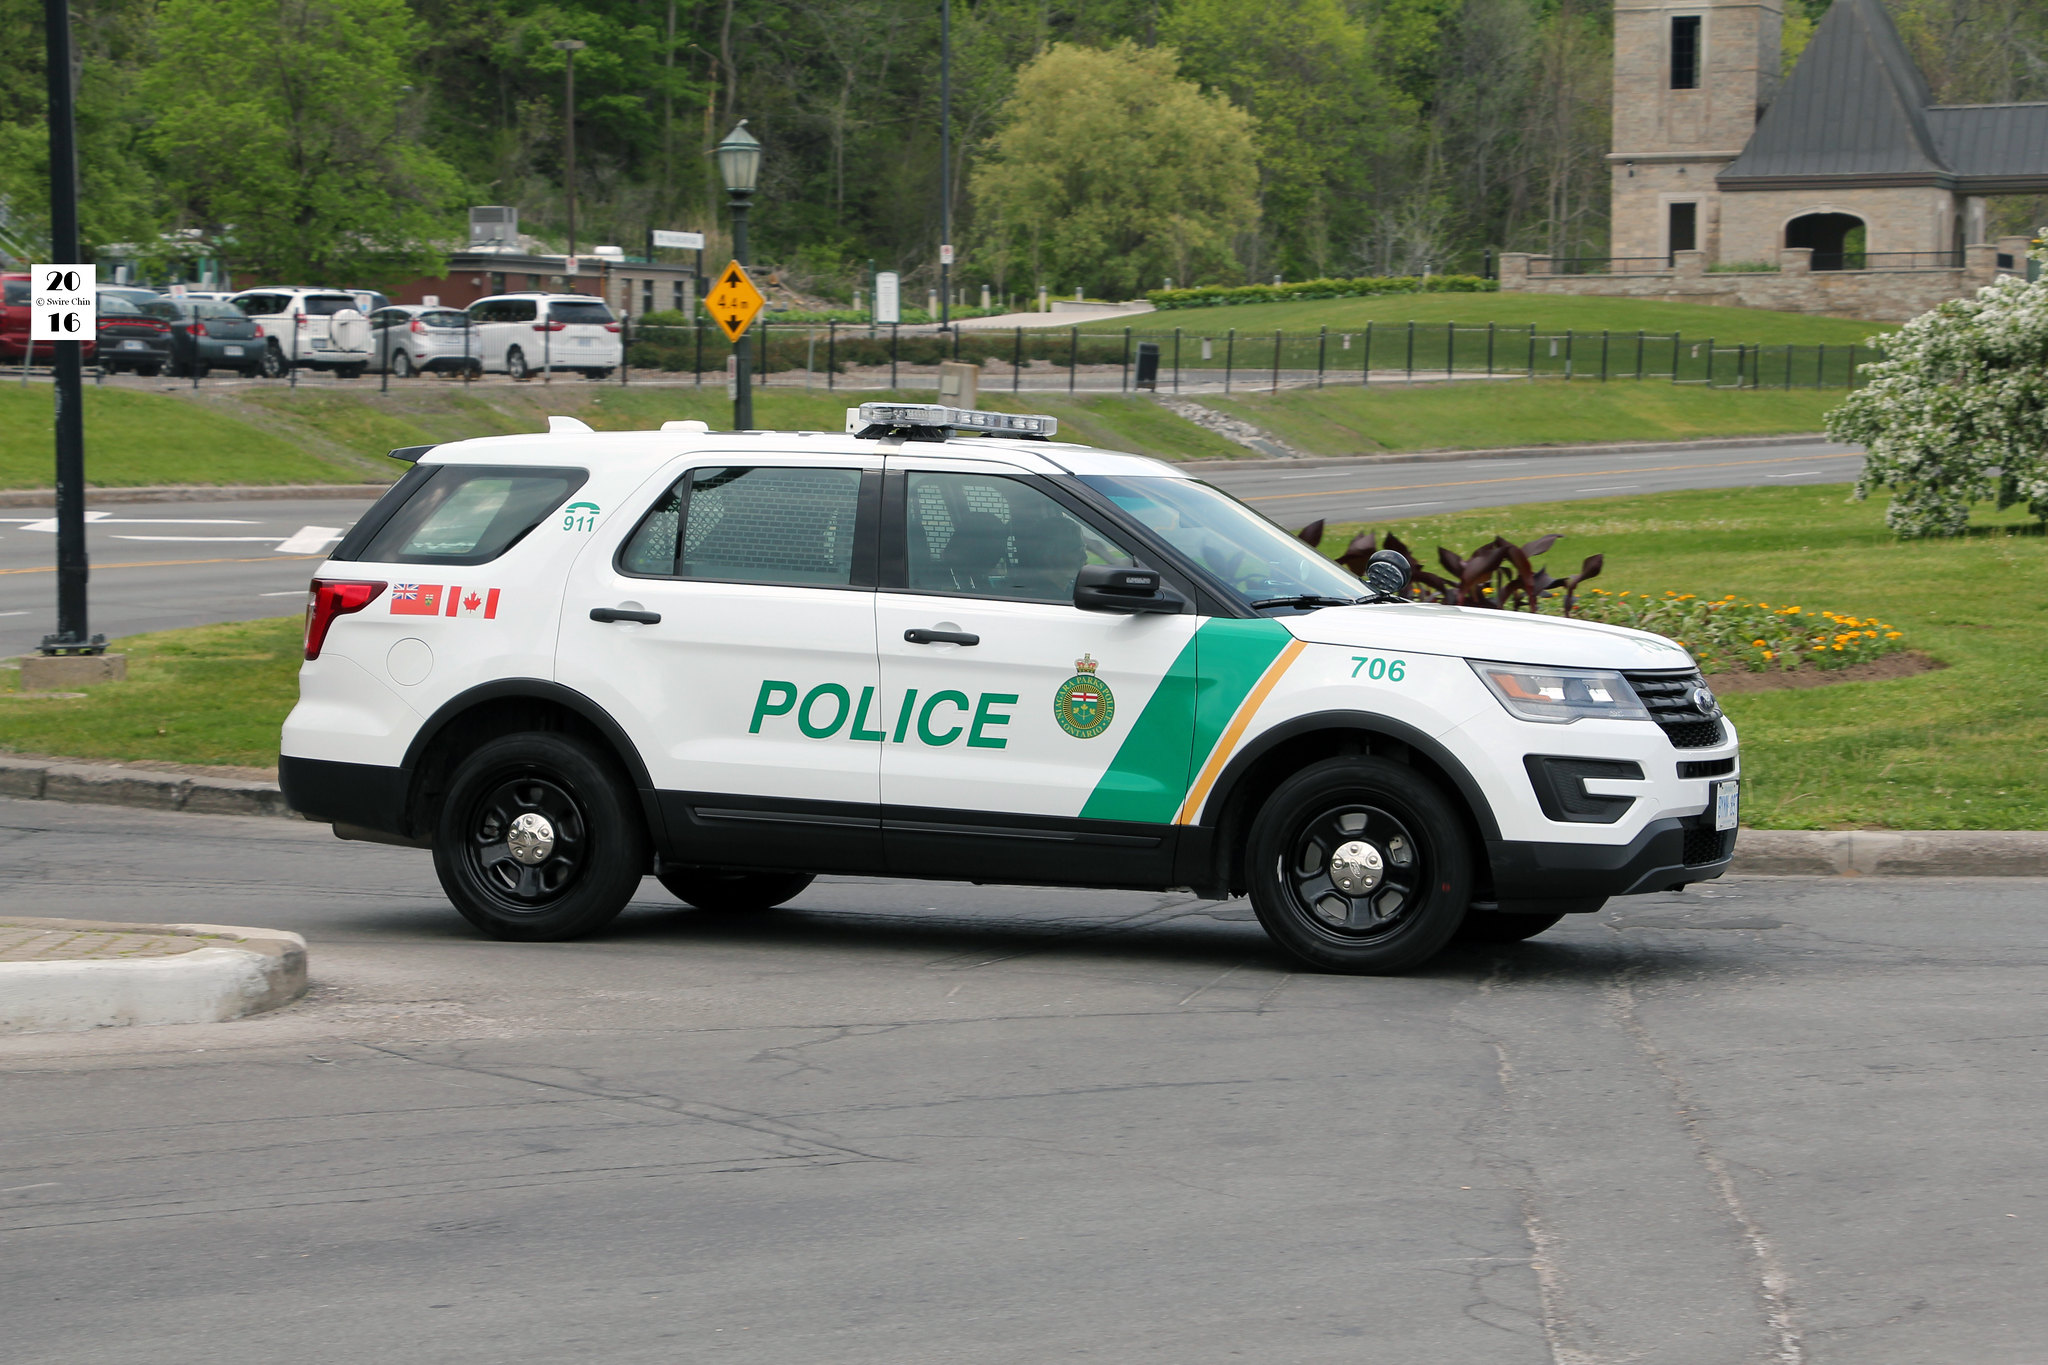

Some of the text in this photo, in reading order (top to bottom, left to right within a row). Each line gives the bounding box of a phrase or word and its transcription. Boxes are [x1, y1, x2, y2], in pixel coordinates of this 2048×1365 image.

[563, 515, 595, 532] 911
[1351, 656, 1406, 682] 706
[1055, 676, 1113, 721] NIAGARA PARKS POLICE
[748, 680, 1019, 749] POLICE
[1063, 722, 1103, 738] ONTARIO
